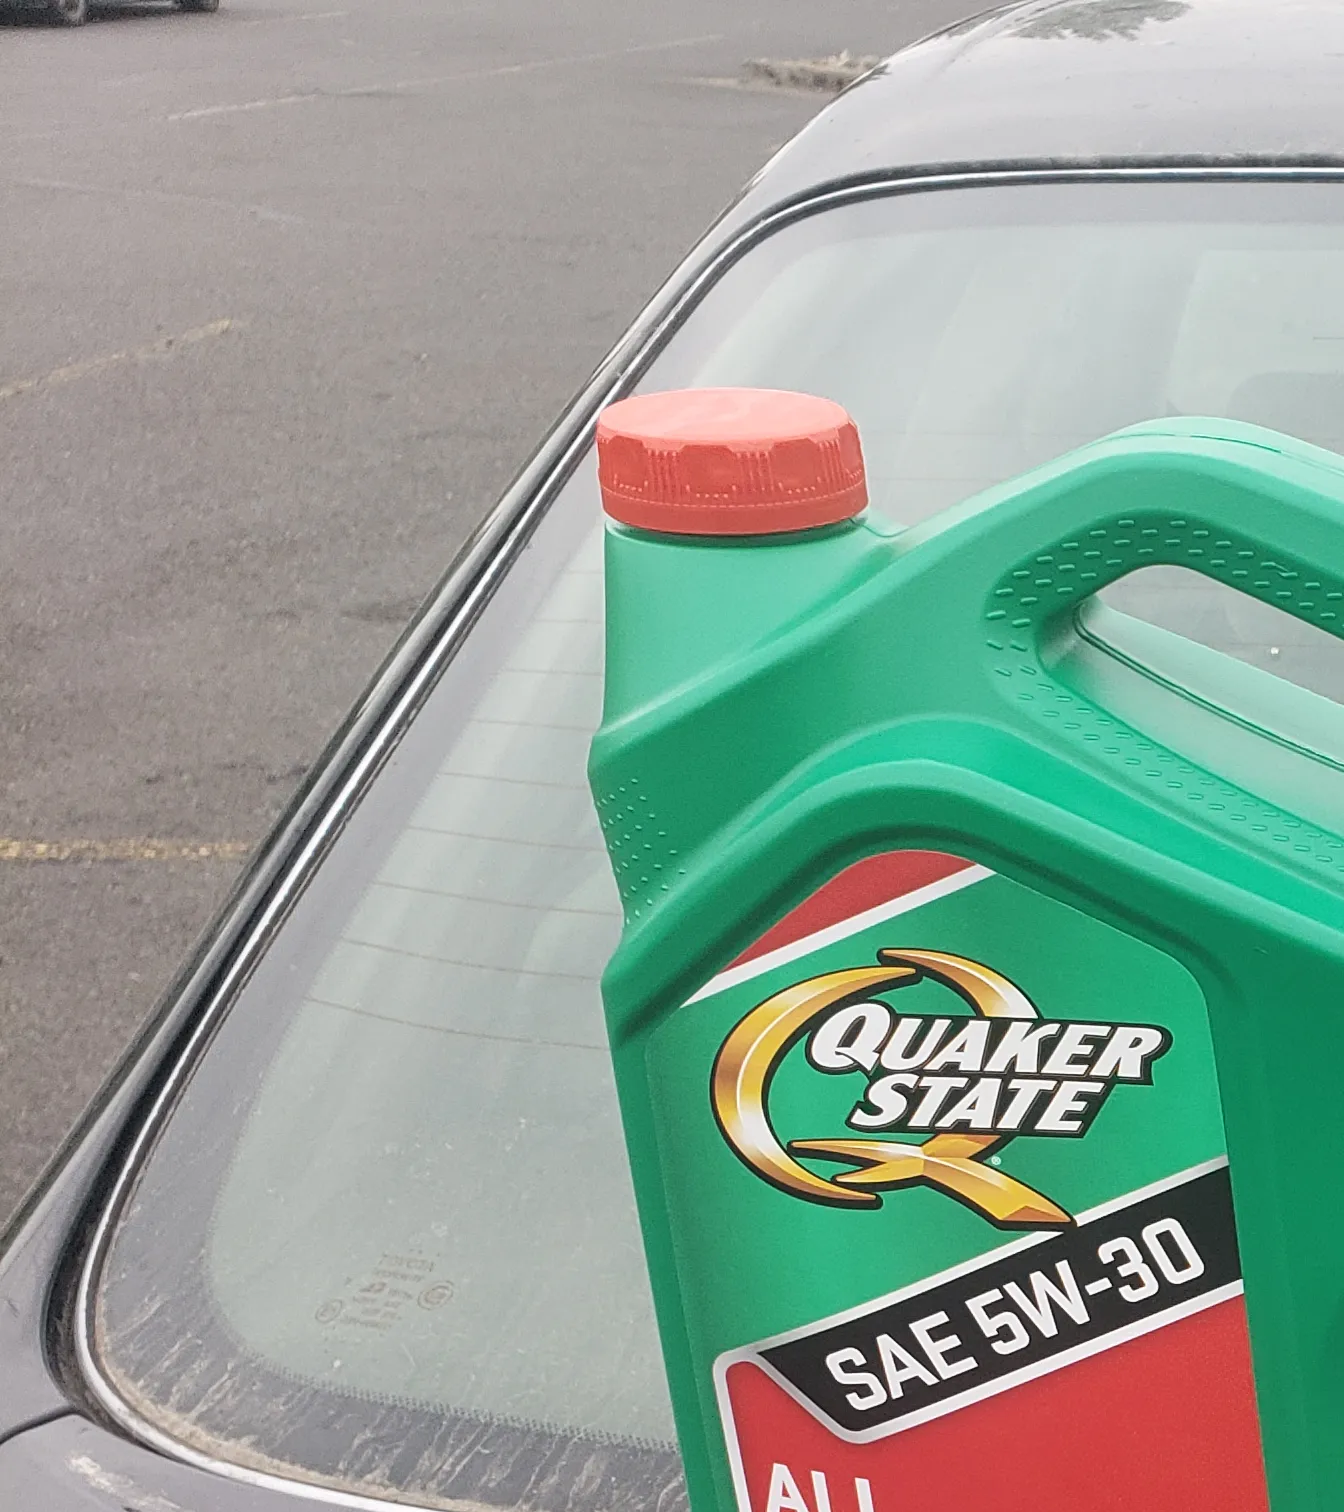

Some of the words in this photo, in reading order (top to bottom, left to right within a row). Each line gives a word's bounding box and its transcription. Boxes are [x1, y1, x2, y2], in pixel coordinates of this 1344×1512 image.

[810, 1003, 1165, 1080] QUAKER
[849, 1076, 1107, 1133] STATE
[824, 1309, 979, 1412] SAE
[965, 1217, 1205, 1357] 5W-30
